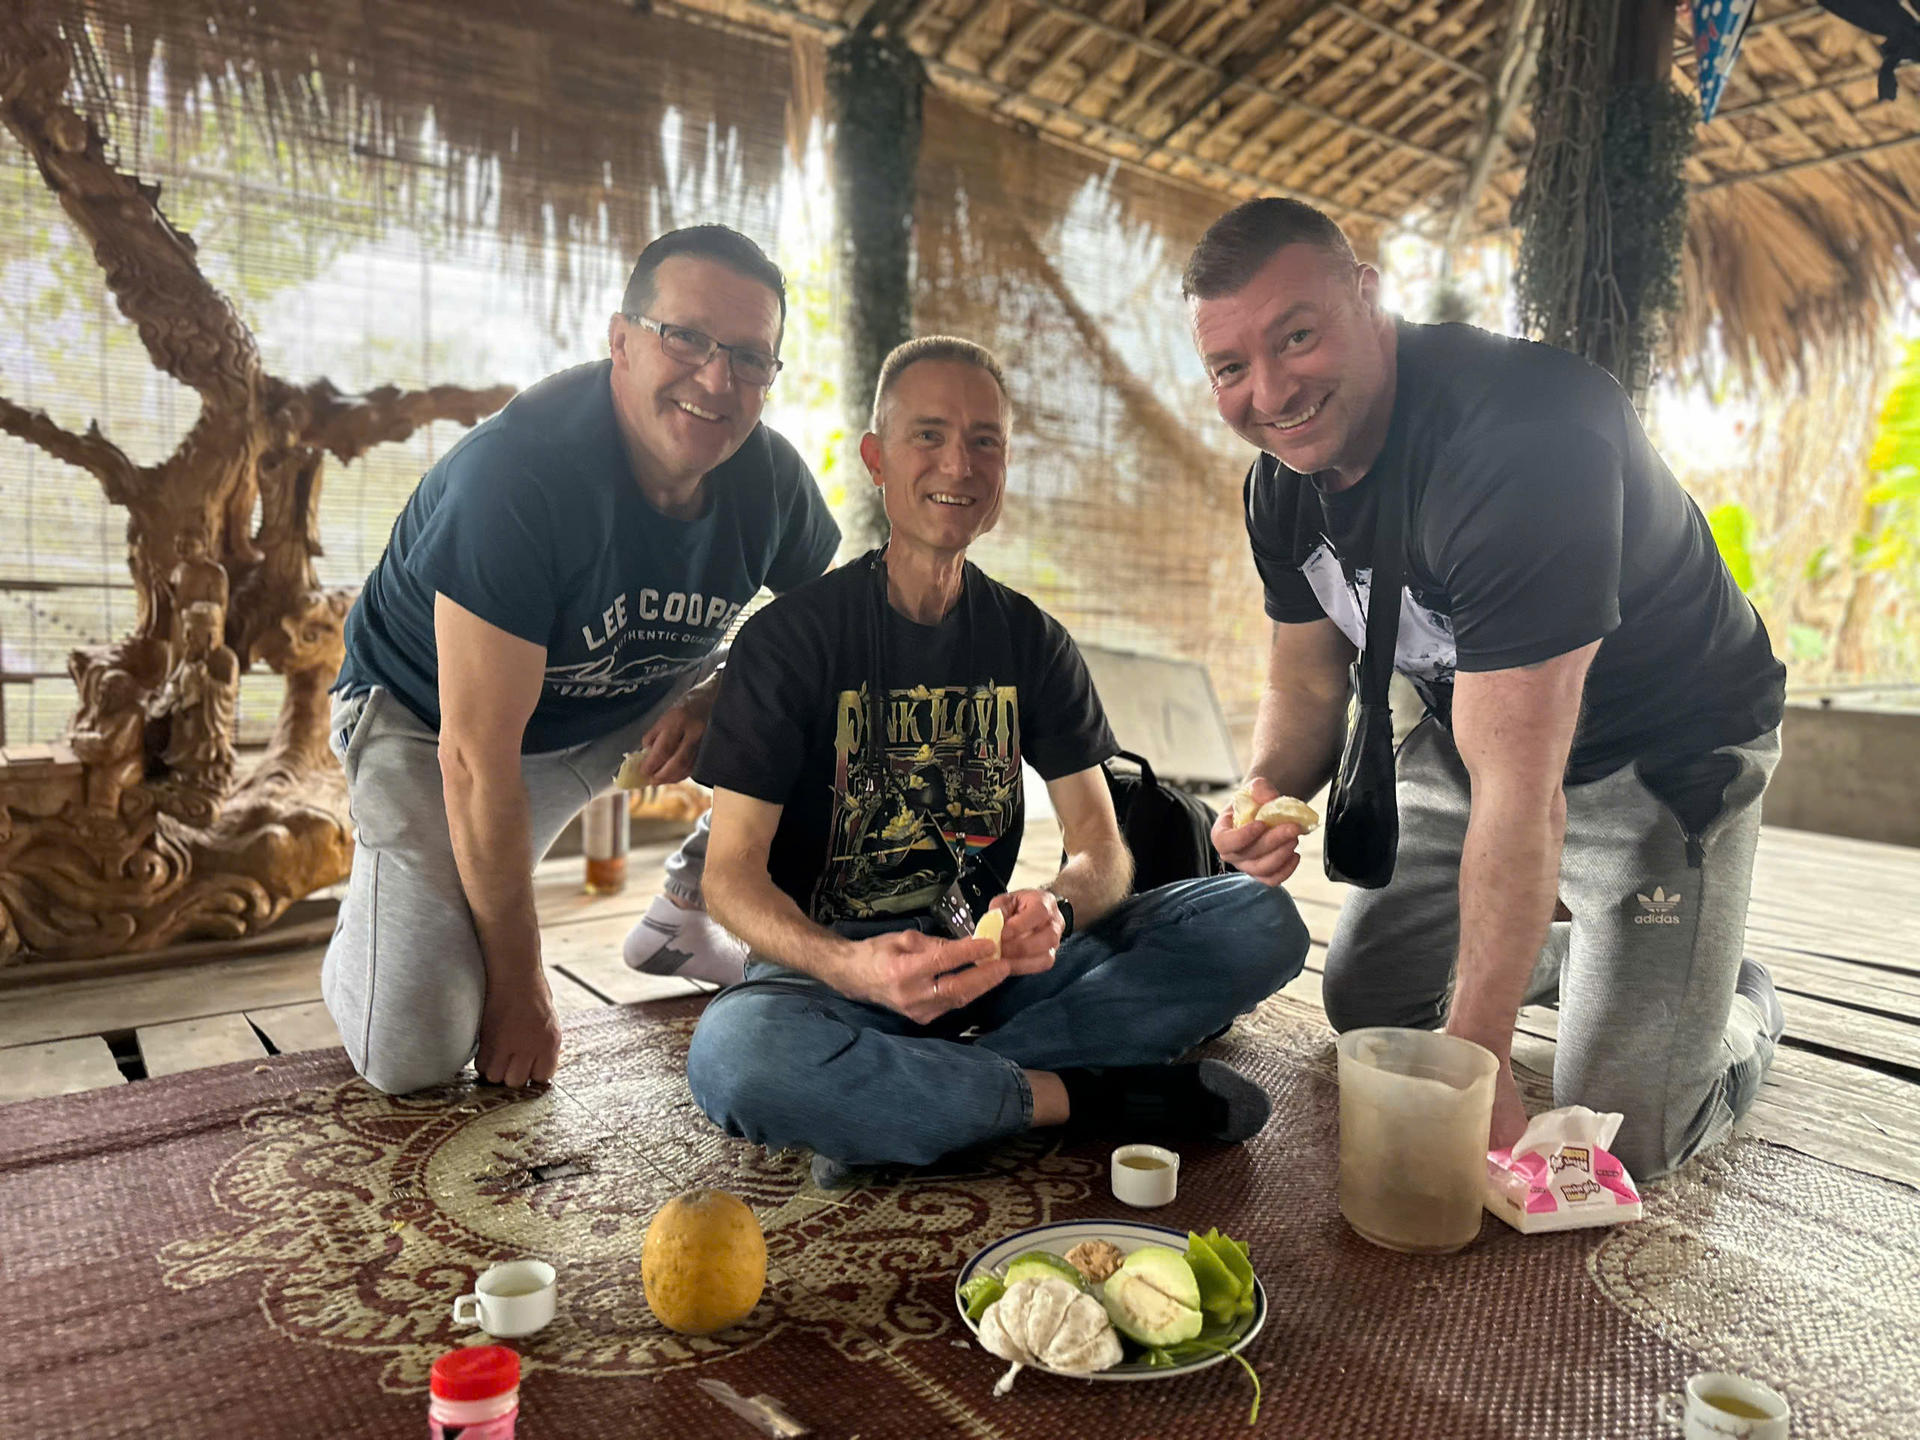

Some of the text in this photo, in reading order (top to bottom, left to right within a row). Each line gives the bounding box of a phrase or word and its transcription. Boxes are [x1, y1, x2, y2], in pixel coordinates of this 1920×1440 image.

[582, 592, 628, 650] LEE
[613, 627, 679, 655] AUTHENTIC
[931, 686, 1020, 770] FLOYD
[1633, 913, 1680, 925] adidas
